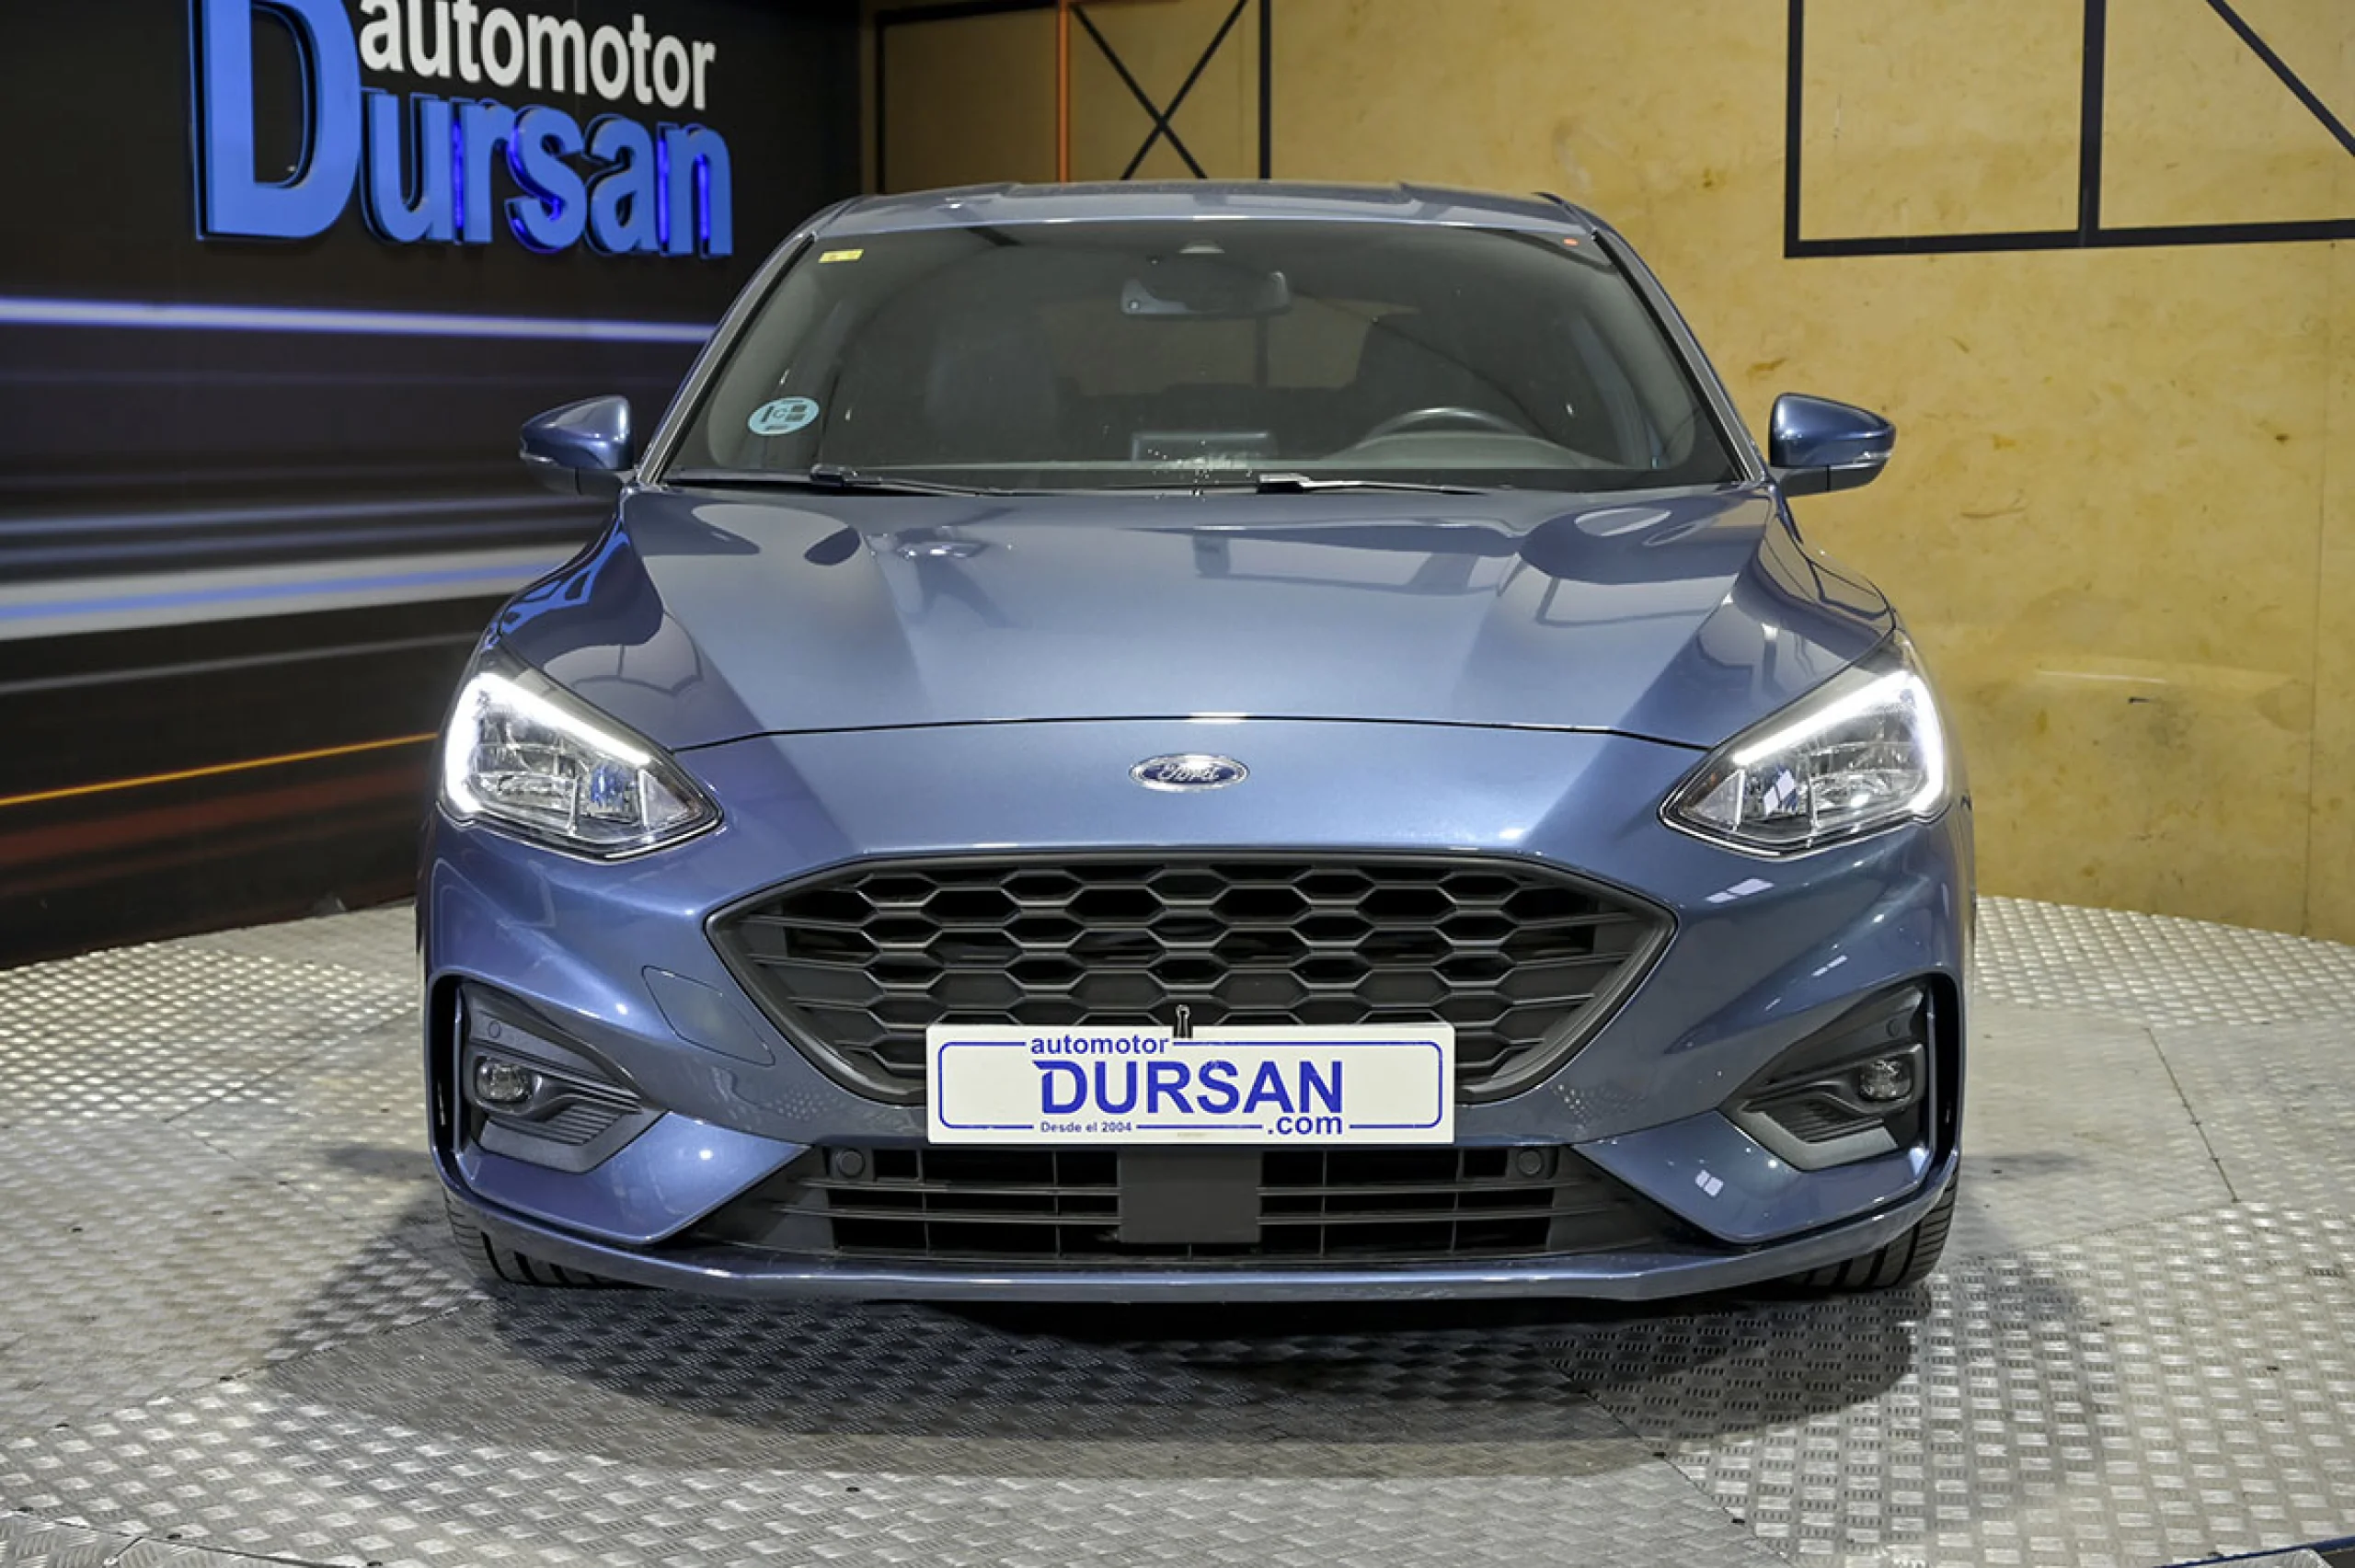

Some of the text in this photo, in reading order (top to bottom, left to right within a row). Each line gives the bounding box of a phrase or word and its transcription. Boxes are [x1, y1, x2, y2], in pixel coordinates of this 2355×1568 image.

[359, 0, 716, 110] automotor
[190, 0, 733, 258] Dursan
[1030, 1035, 1169, 1054] automotor
[1032, 1059, 1343, 1115] DURSAN
[1040, 1121, 1132, 1133] Desde el 2004
[1267, 1116, 1343, 1135] .com
